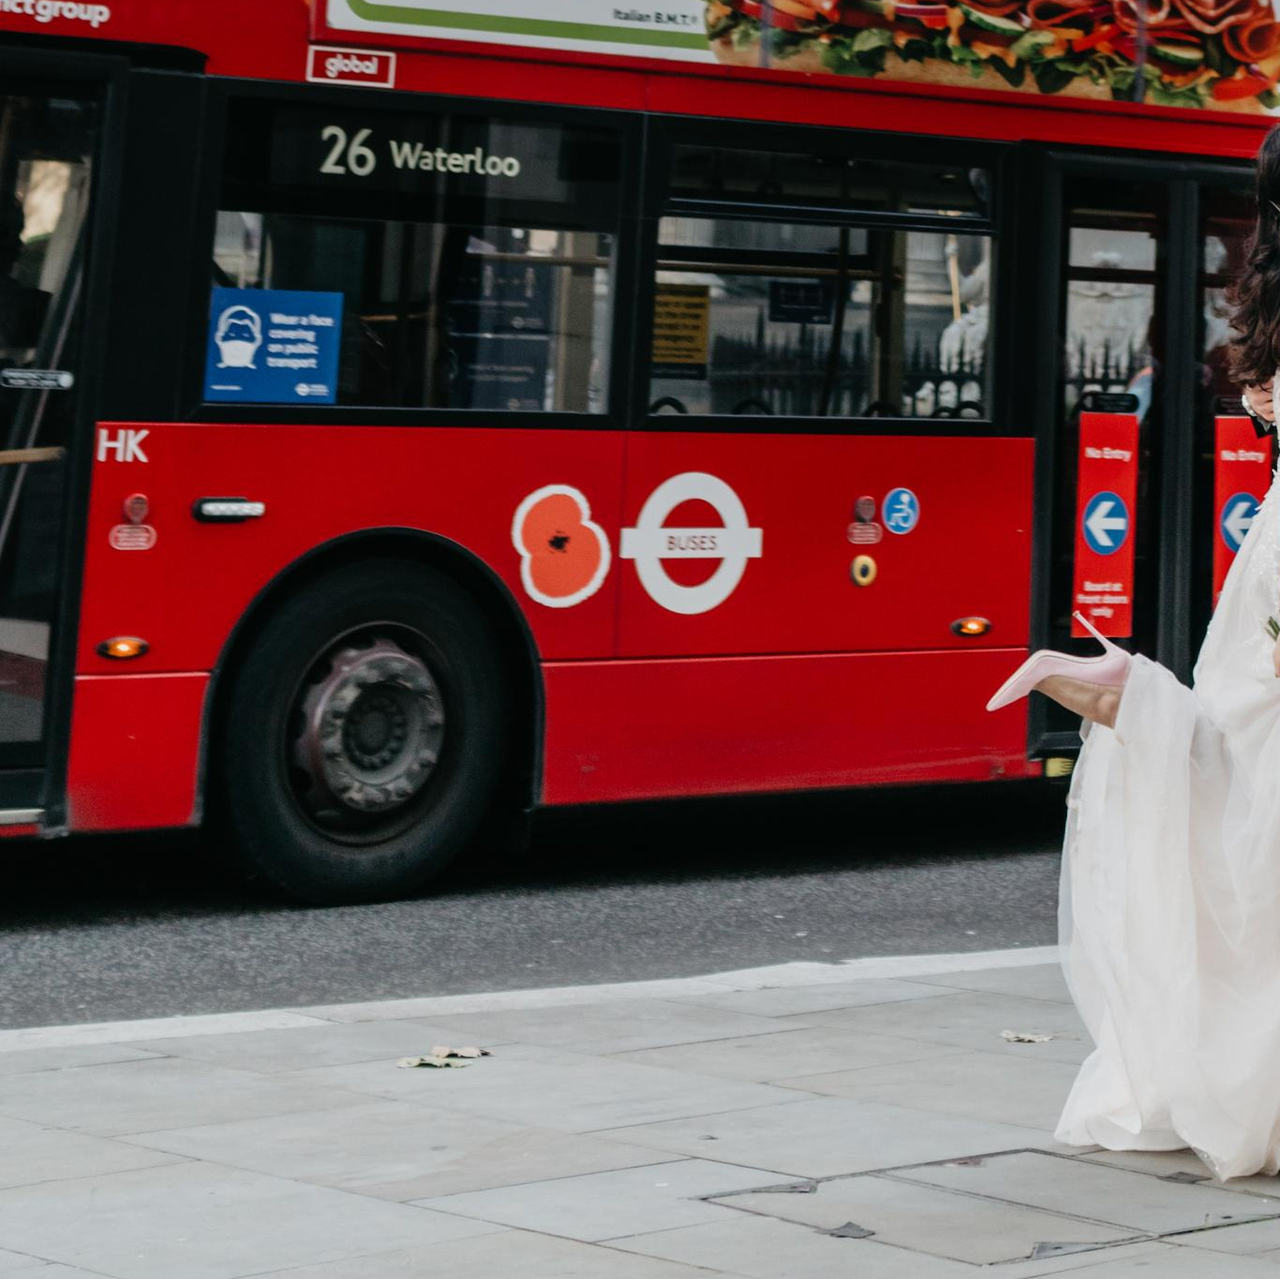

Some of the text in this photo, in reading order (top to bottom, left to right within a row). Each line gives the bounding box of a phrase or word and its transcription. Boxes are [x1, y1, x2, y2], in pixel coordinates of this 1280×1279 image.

[613, 8, 651, 22] Italian
[325, 53, 378, 78] global
[319, 125, 521, 177] 26 Waterloo
[97, 429, 150, 463] HK
[1085, 447, 1132, 462] No Entry
[1220, 449, 1266, 463] No Entry
[667, 535, 717, 550] BUSES
